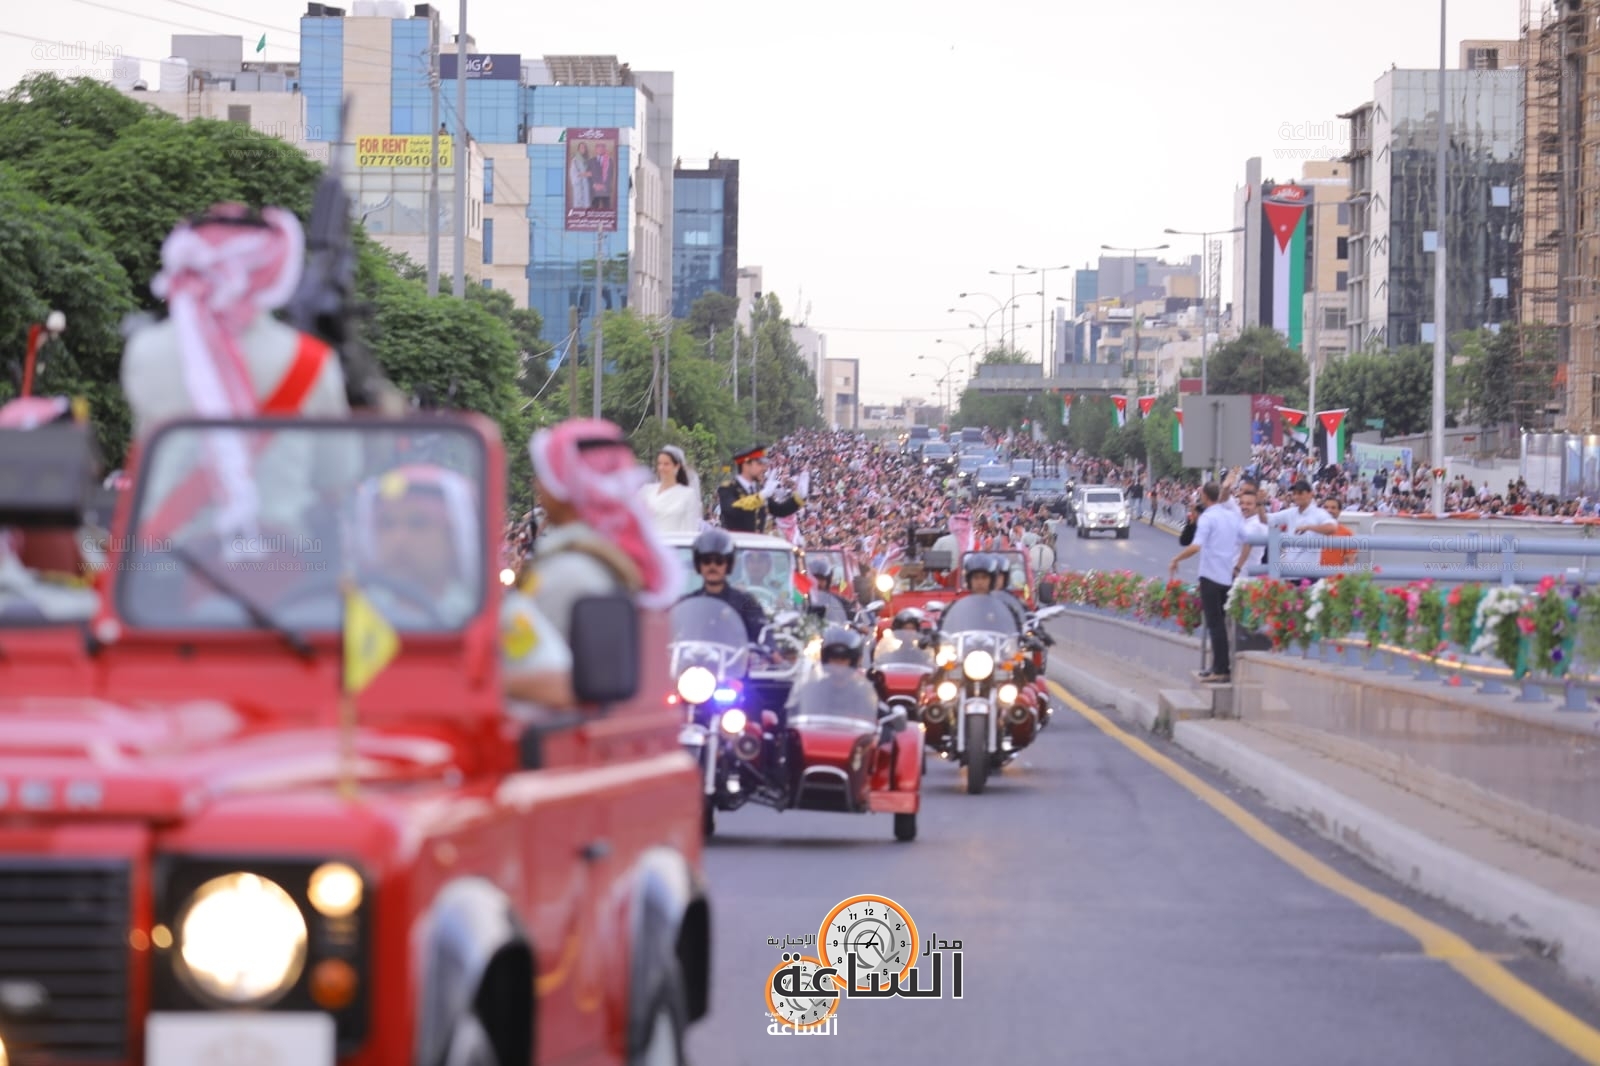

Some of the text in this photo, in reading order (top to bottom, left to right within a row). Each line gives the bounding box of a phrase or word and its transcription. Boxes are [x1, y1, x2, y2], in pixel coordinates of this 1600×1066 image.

[359, 138, 379, 153] FOR
[382, 138, 408, 153] RENT
[360, 155, 448, 166] 077760100
